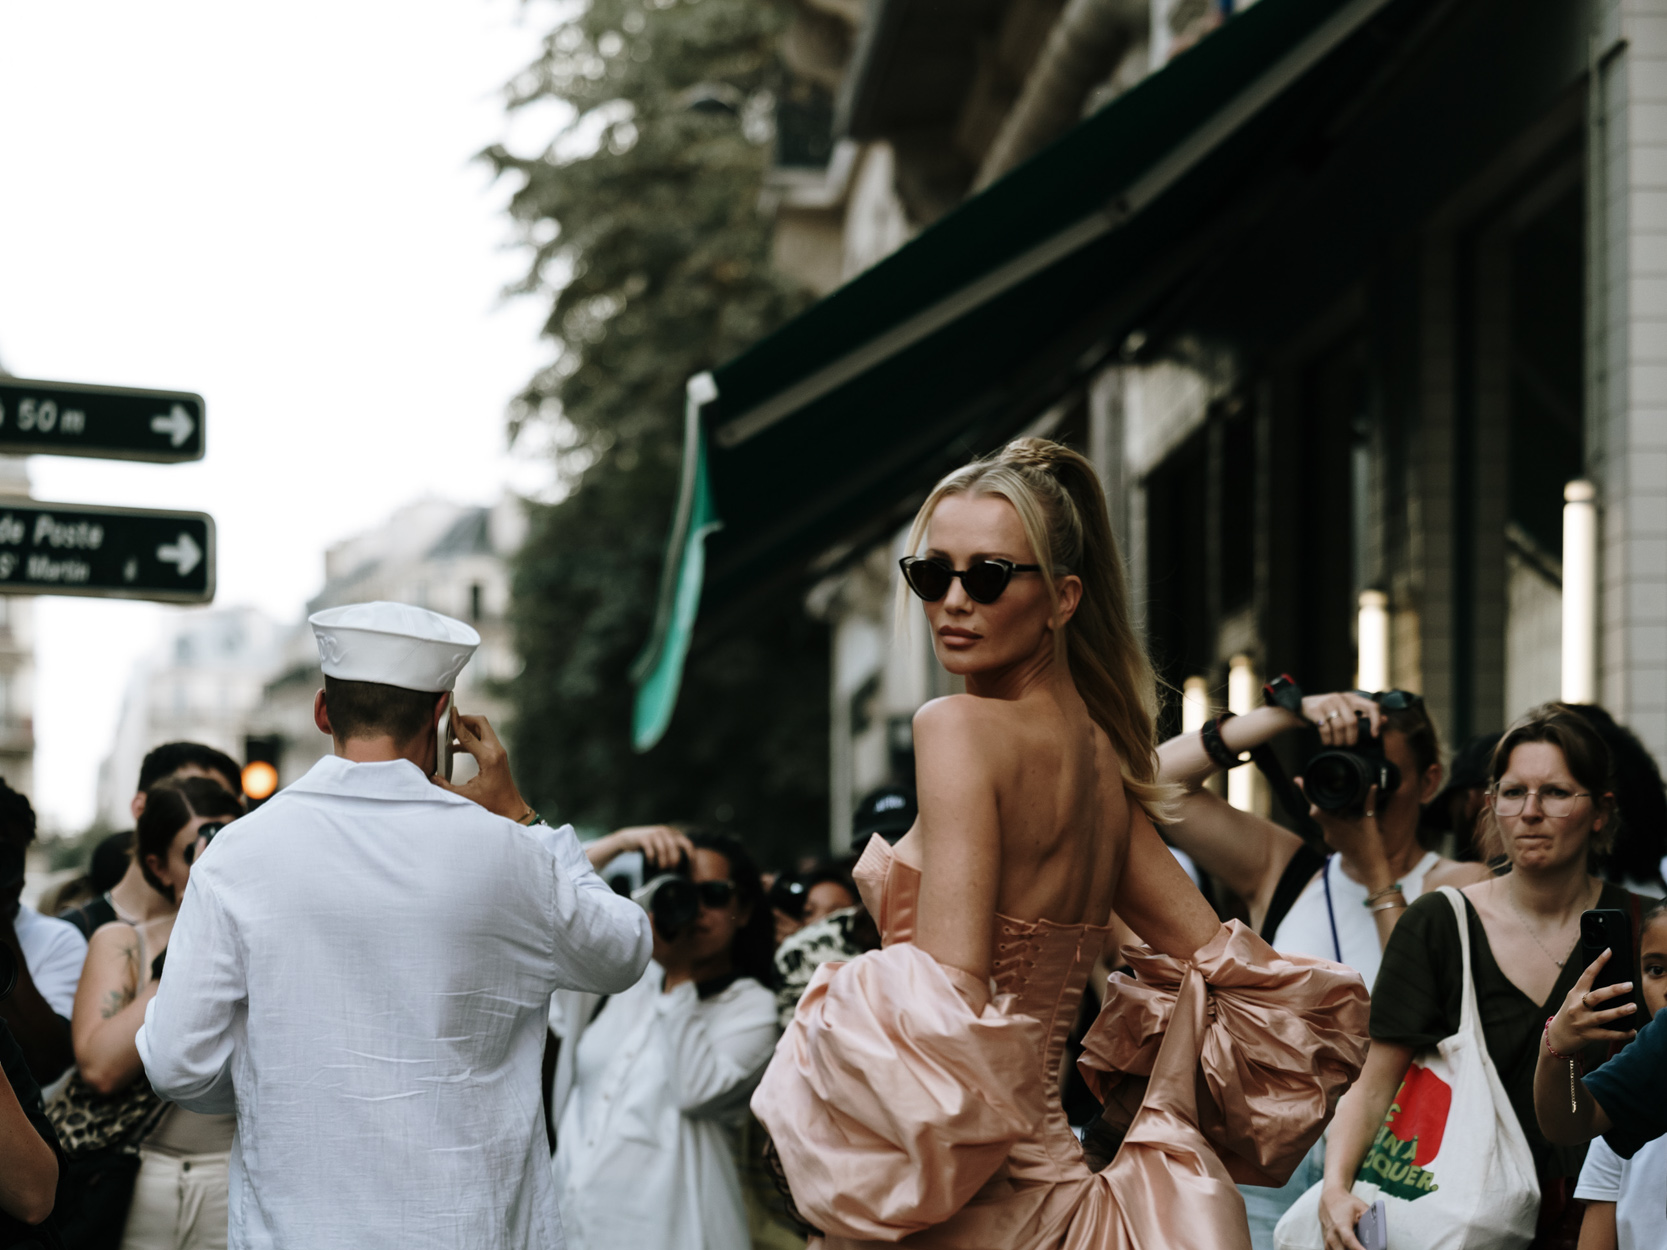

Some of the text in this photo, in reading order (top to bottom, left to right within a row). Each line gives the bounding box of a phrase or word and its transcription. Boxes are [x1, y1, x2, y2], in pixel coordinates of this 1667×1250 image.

[17, 397, 57, 432] 50
[60, 409, 86, 434] m
[33, 514, 104, 549] Poste
[27, 554, 90, 582] Martin
[1363, 1149, 1439, 1191] OQUER.
